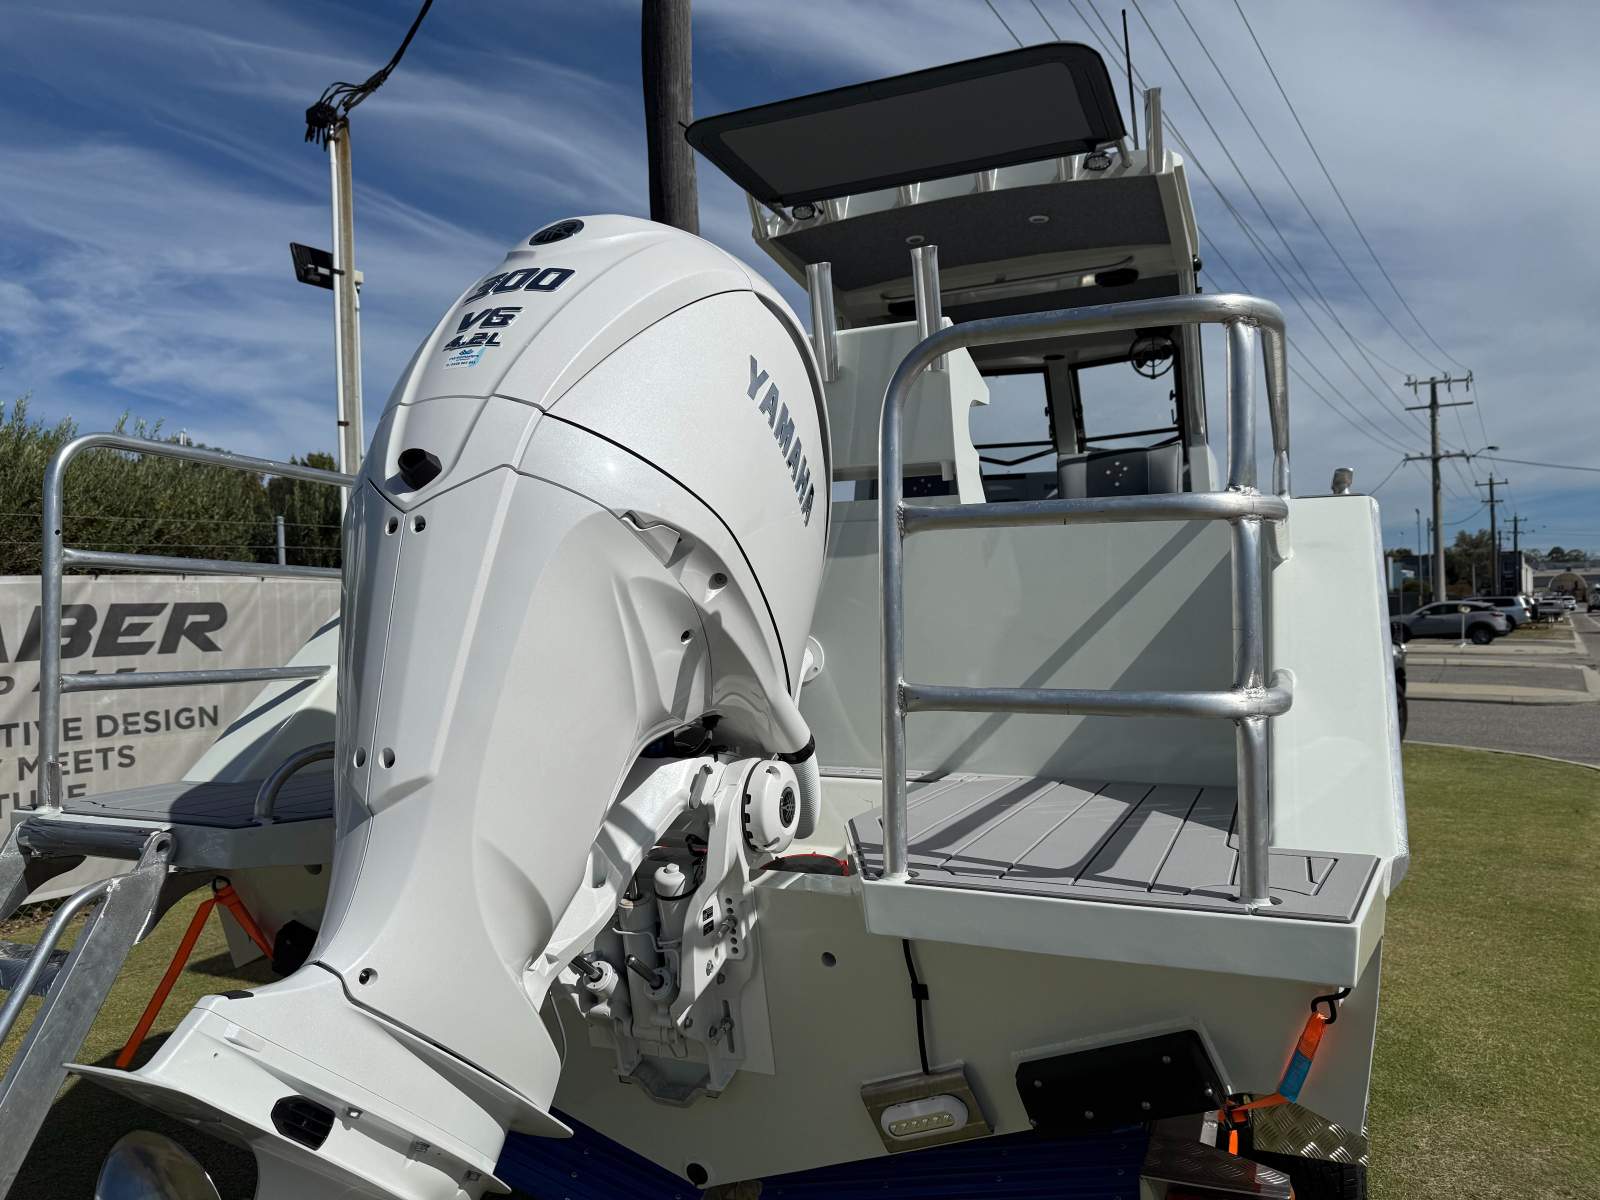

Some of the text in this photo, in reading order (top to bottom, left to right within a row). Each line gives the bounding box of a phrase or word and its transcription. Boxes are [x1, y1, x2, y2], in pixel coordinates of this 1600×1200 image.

[442, 332, 502, 352] 4.2L
[456, 306, 524, 335] V6
[746, 354, 815, 528] YAMAHA
[0, 602, 228, 663] BER
[0, 705, 219, 748] TIE DESIGN
